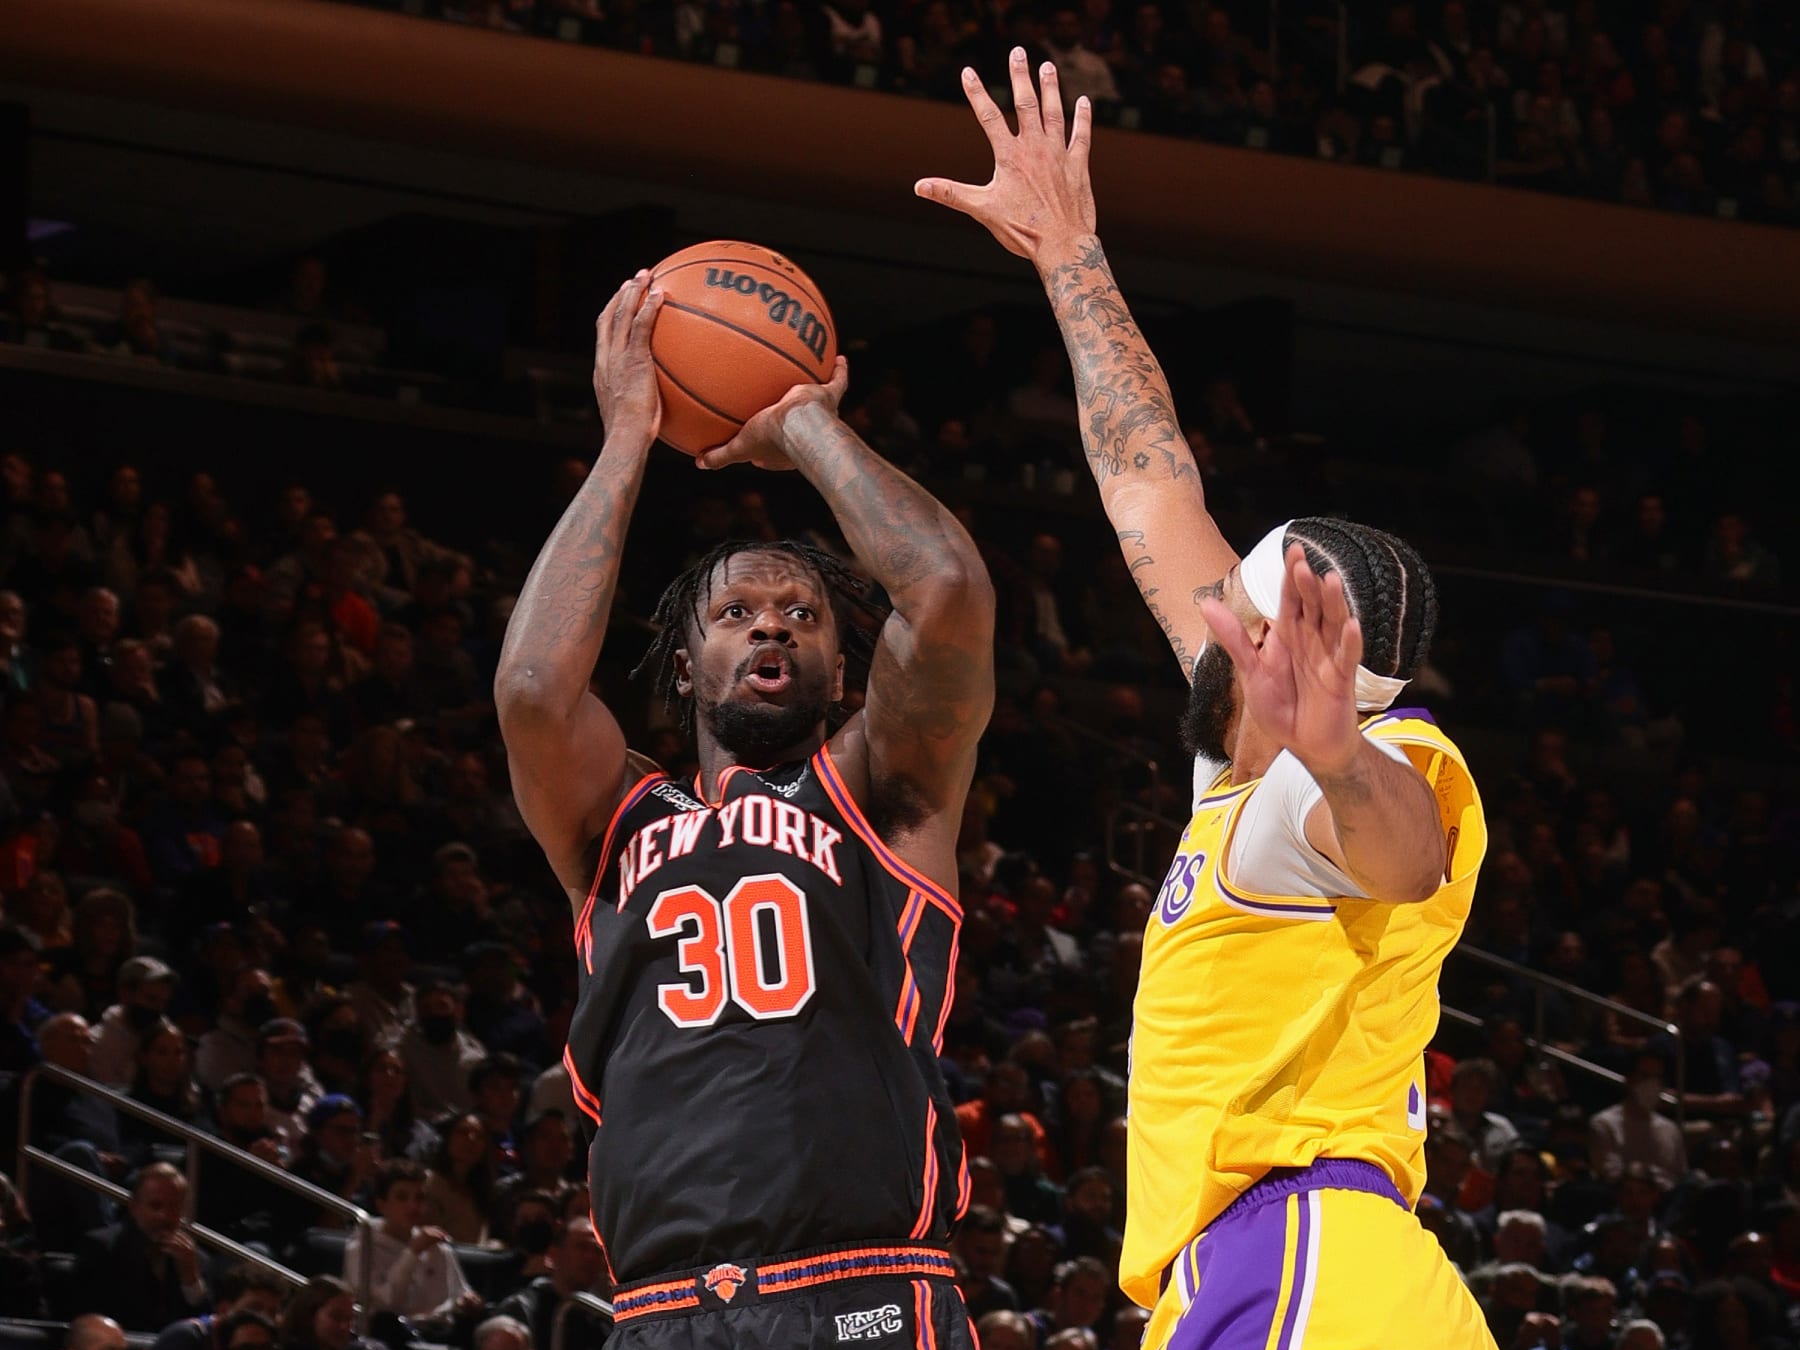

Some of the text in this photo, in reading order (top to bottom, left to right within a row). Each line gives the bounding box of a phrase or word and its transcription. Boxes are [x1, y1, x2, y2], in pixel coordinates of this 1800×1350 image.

[705, 267, 828, 364] Wilson
[617, 794, 843, 914] NEW YORK
[645, 872, 817, 1029] 30
[706, 1266, 746, 1288] KNICKS
[834, 1304, 903, 1341] NYC
